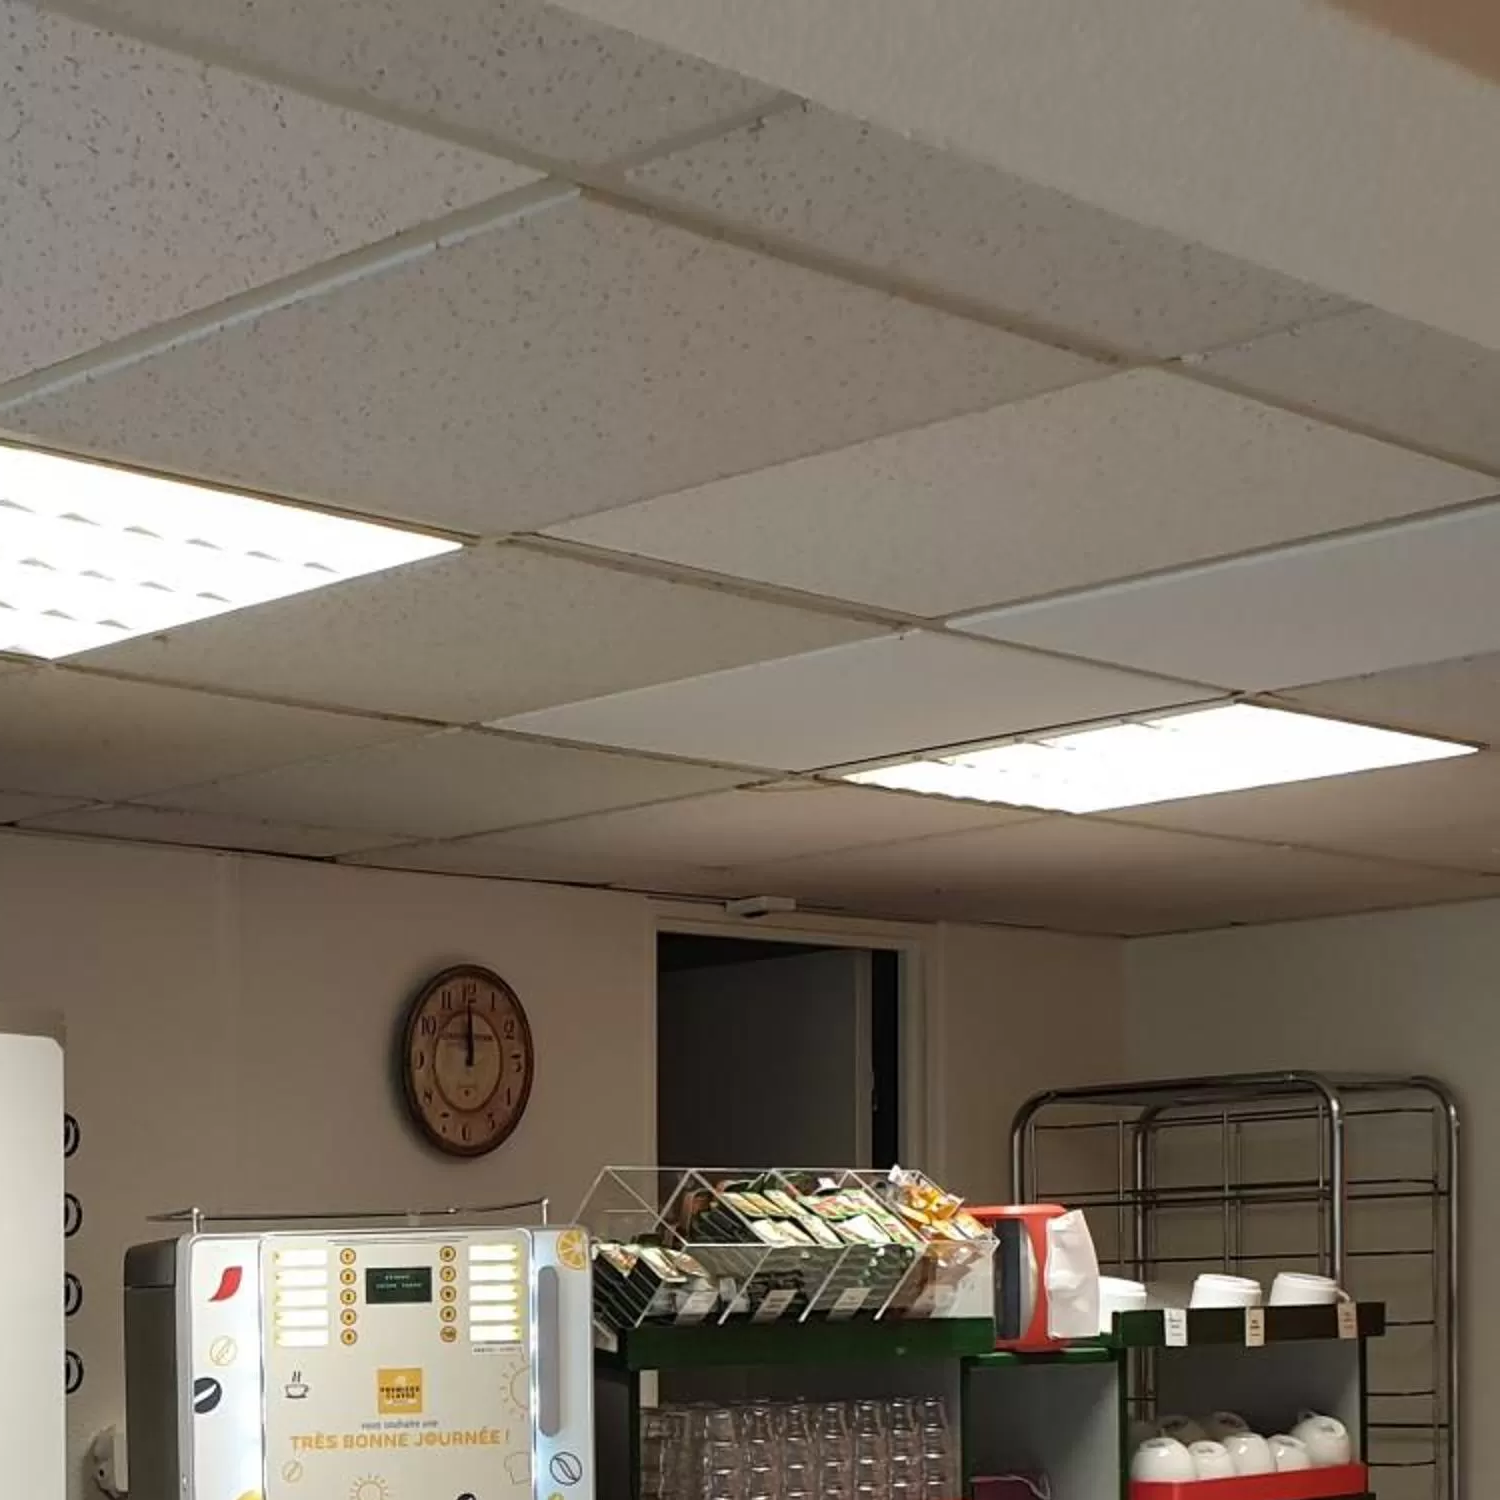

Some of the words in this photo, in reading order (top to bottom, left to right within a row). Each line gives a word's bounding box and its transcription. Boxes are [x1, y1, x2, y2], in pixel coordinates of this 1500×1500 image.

[441, 991, 453, 1011] 11
[461, 981, 477, 1004] 12
[490, 991, 497, 1012] 1
[420, 1015, 437, 1037] 10
[503, 1019, 515, 1041] 2
[290, 1432, 337, 1450] TRÈS
[343, 1431, 410, 1448] BONNE
[412, 1425, 502, 1447] JOURNÉE
[505, 1427, 510, 1441] !
